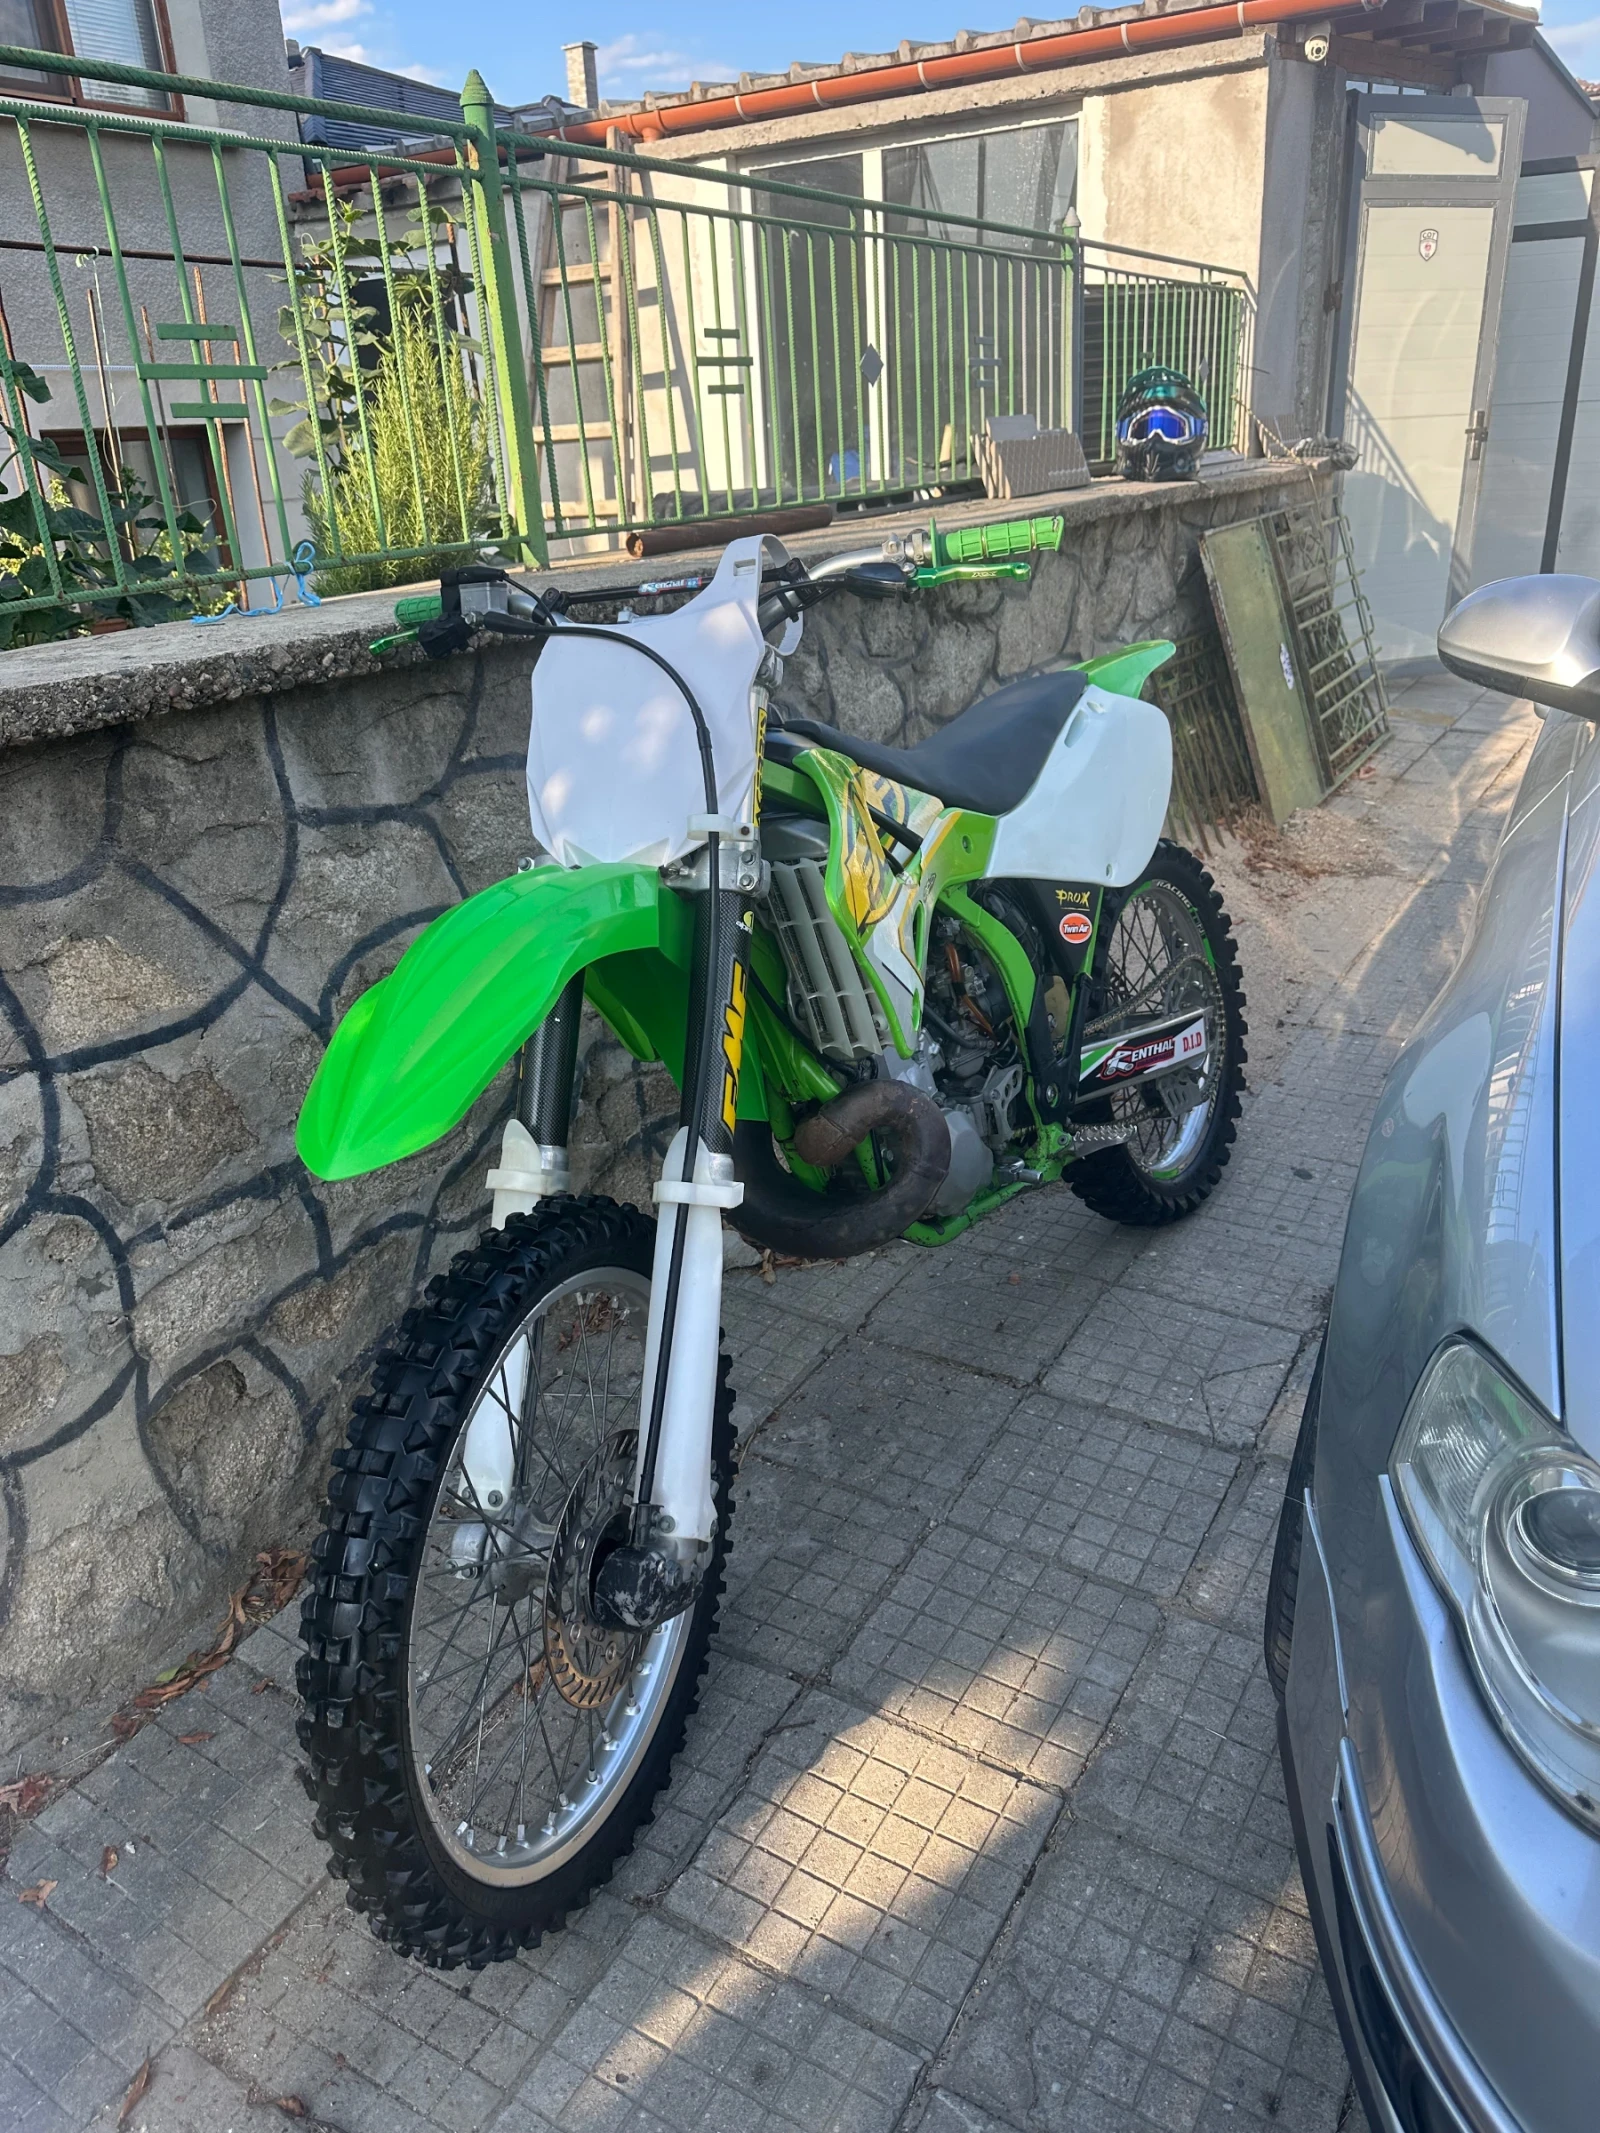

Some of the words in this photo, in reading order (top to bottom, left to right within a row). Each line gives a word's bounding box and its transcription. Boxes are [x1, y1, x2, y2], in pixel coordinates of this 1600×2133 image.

[1063, 923, 1079, 934] Twin
[1079, 923, 1090, 933] Air
[1182, 1031, 1203, 1052] D.I.D
